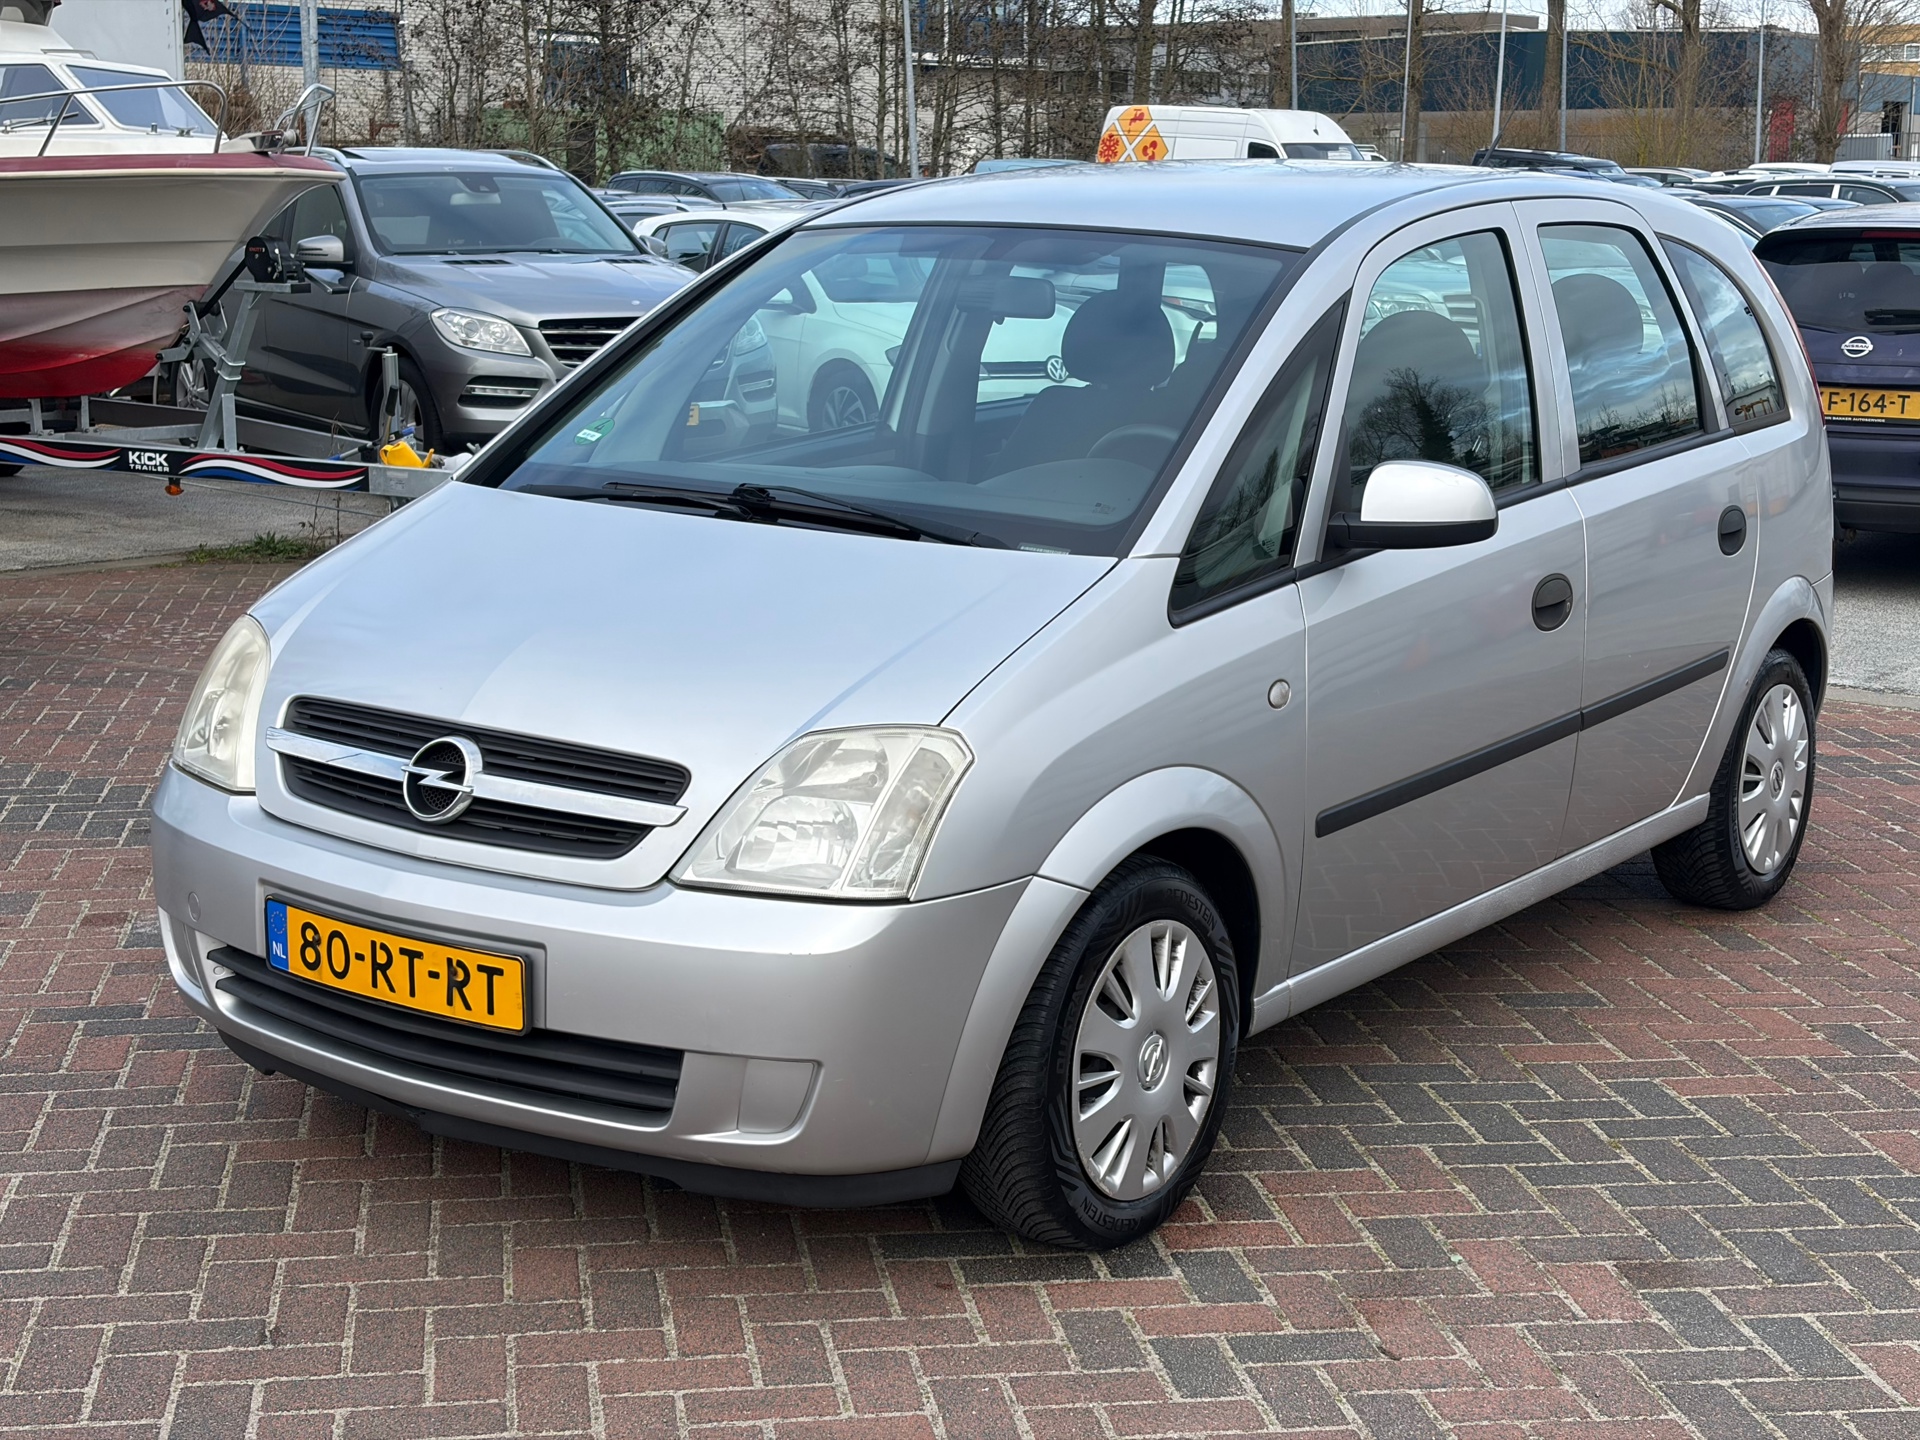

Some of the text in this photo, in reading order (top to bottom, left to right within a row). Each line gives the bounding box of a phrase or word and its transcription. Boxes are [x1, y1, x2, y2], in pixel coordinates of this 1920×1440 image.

[129, 464, 170, 472] TRAILER
[1164, 888, 1218, 931] REDESTEIN
[272, 940, 286, 960] NL
[300, 921, 504, 1016] 80-RT-RT
